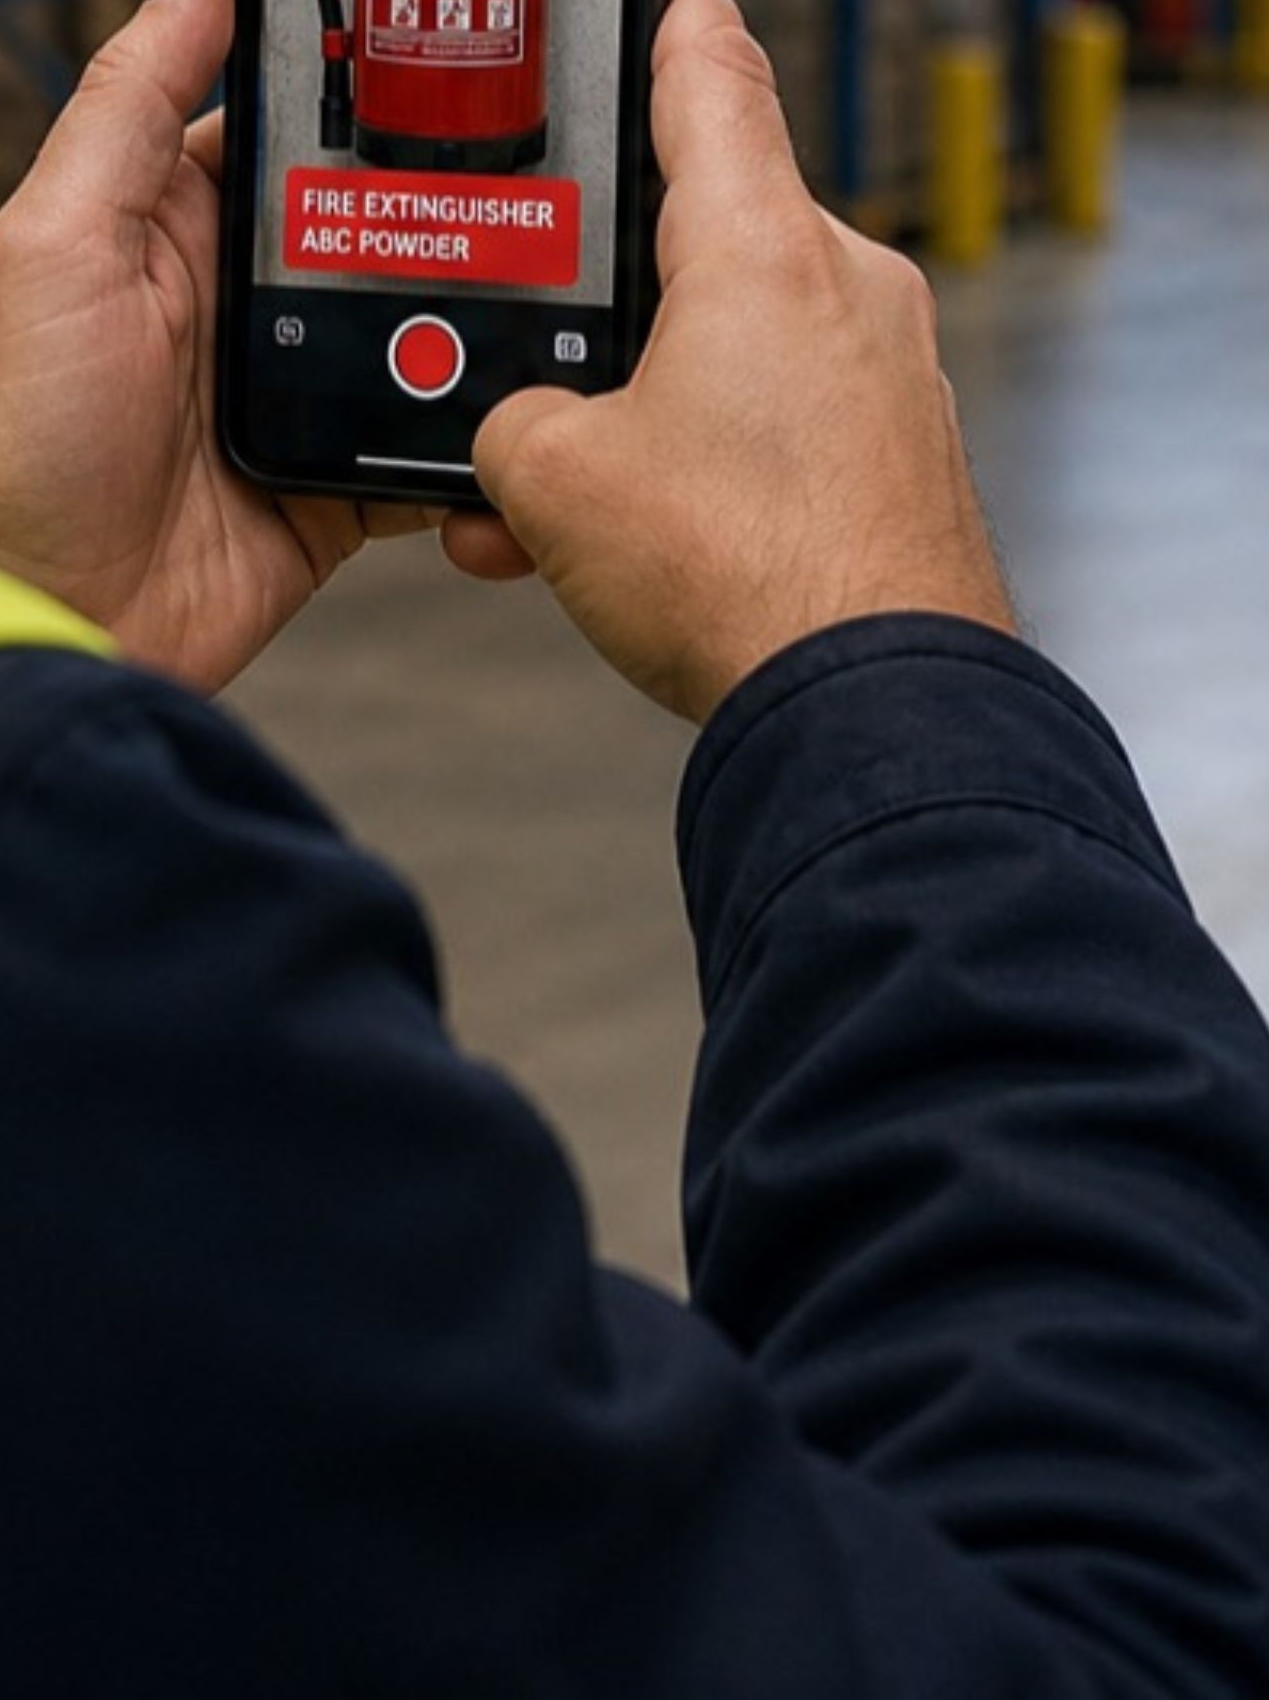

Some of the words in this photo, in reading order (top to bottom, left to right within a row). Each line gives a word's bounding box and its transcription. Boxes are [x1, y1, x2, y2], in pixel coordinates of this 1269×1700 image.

[302, 188, 357, 218] FIRE
[364, 192, 555, 229] EXTINGUISHER
[301, 227, 351, 254] ABC
[359, 230, 470, 261] POWDER
